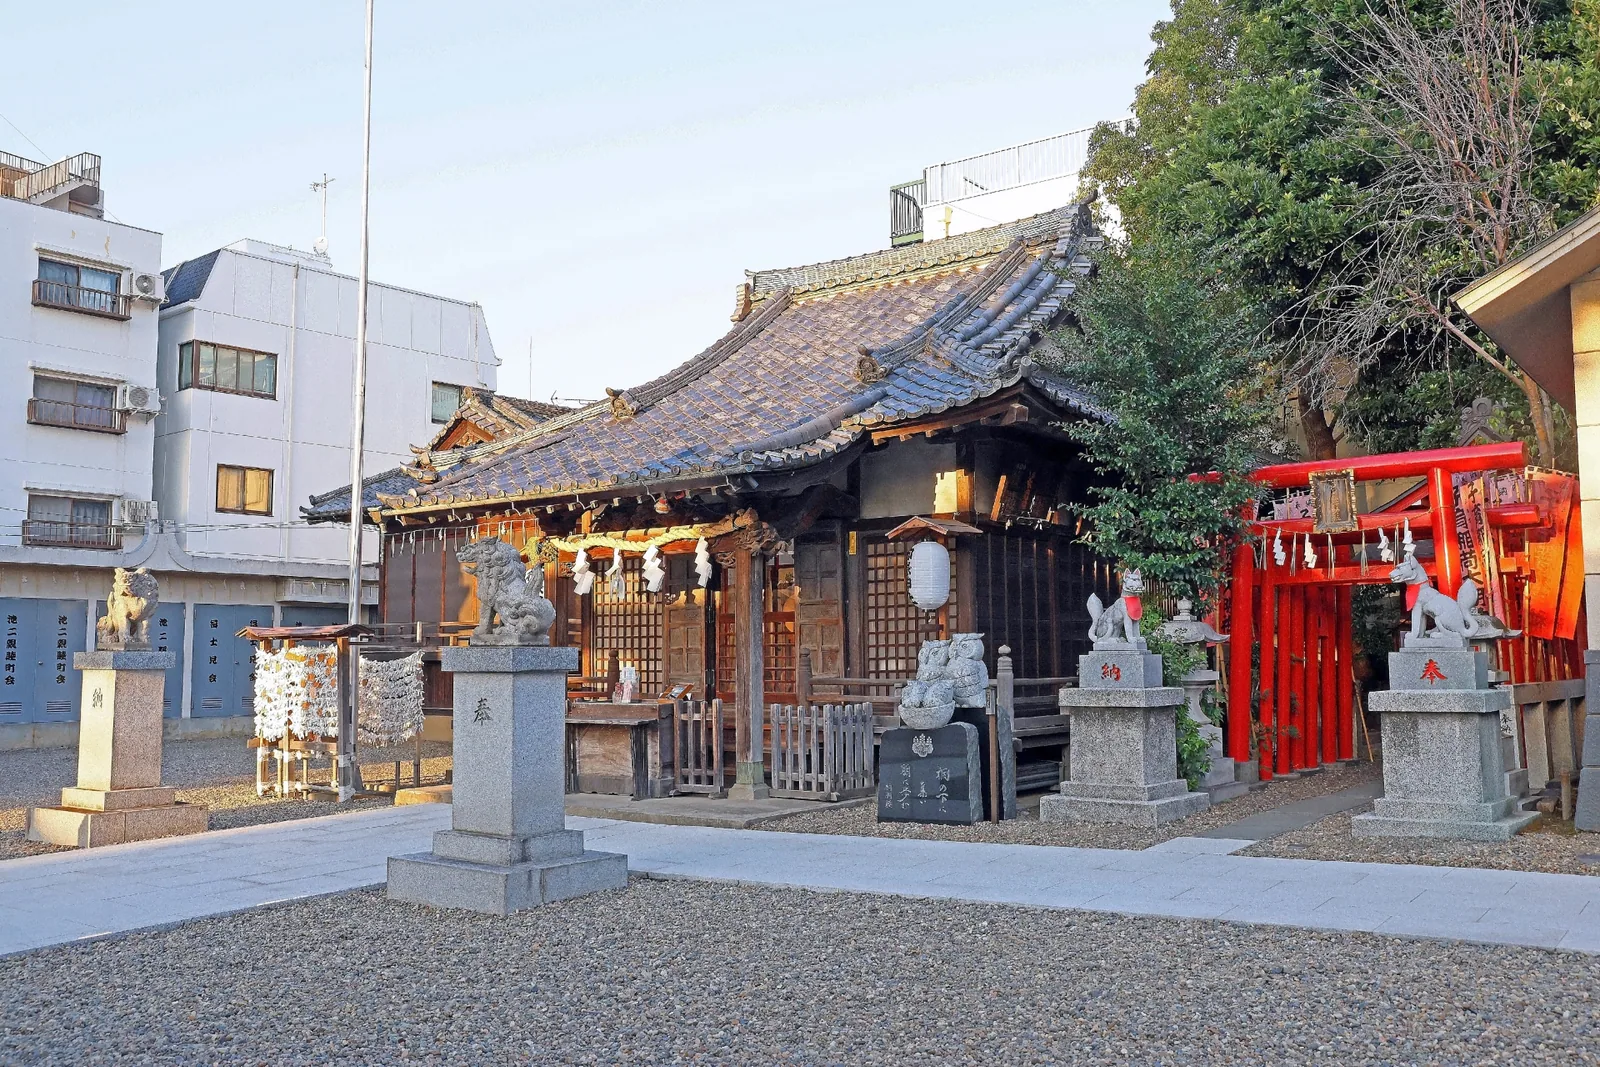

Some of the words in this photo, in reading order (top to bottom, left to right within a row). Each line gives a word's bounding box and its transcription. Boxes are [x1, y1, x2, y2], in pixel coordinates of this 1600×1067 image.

[5, 614, 18, 685] 池二親睦町会
[56, 615, 68, 684] 池二親睦町会
[1101, 663, 1121, 681] 納
[1420, 659, 1447, 685] 奉
[473, 697, 493, 726] 奉
